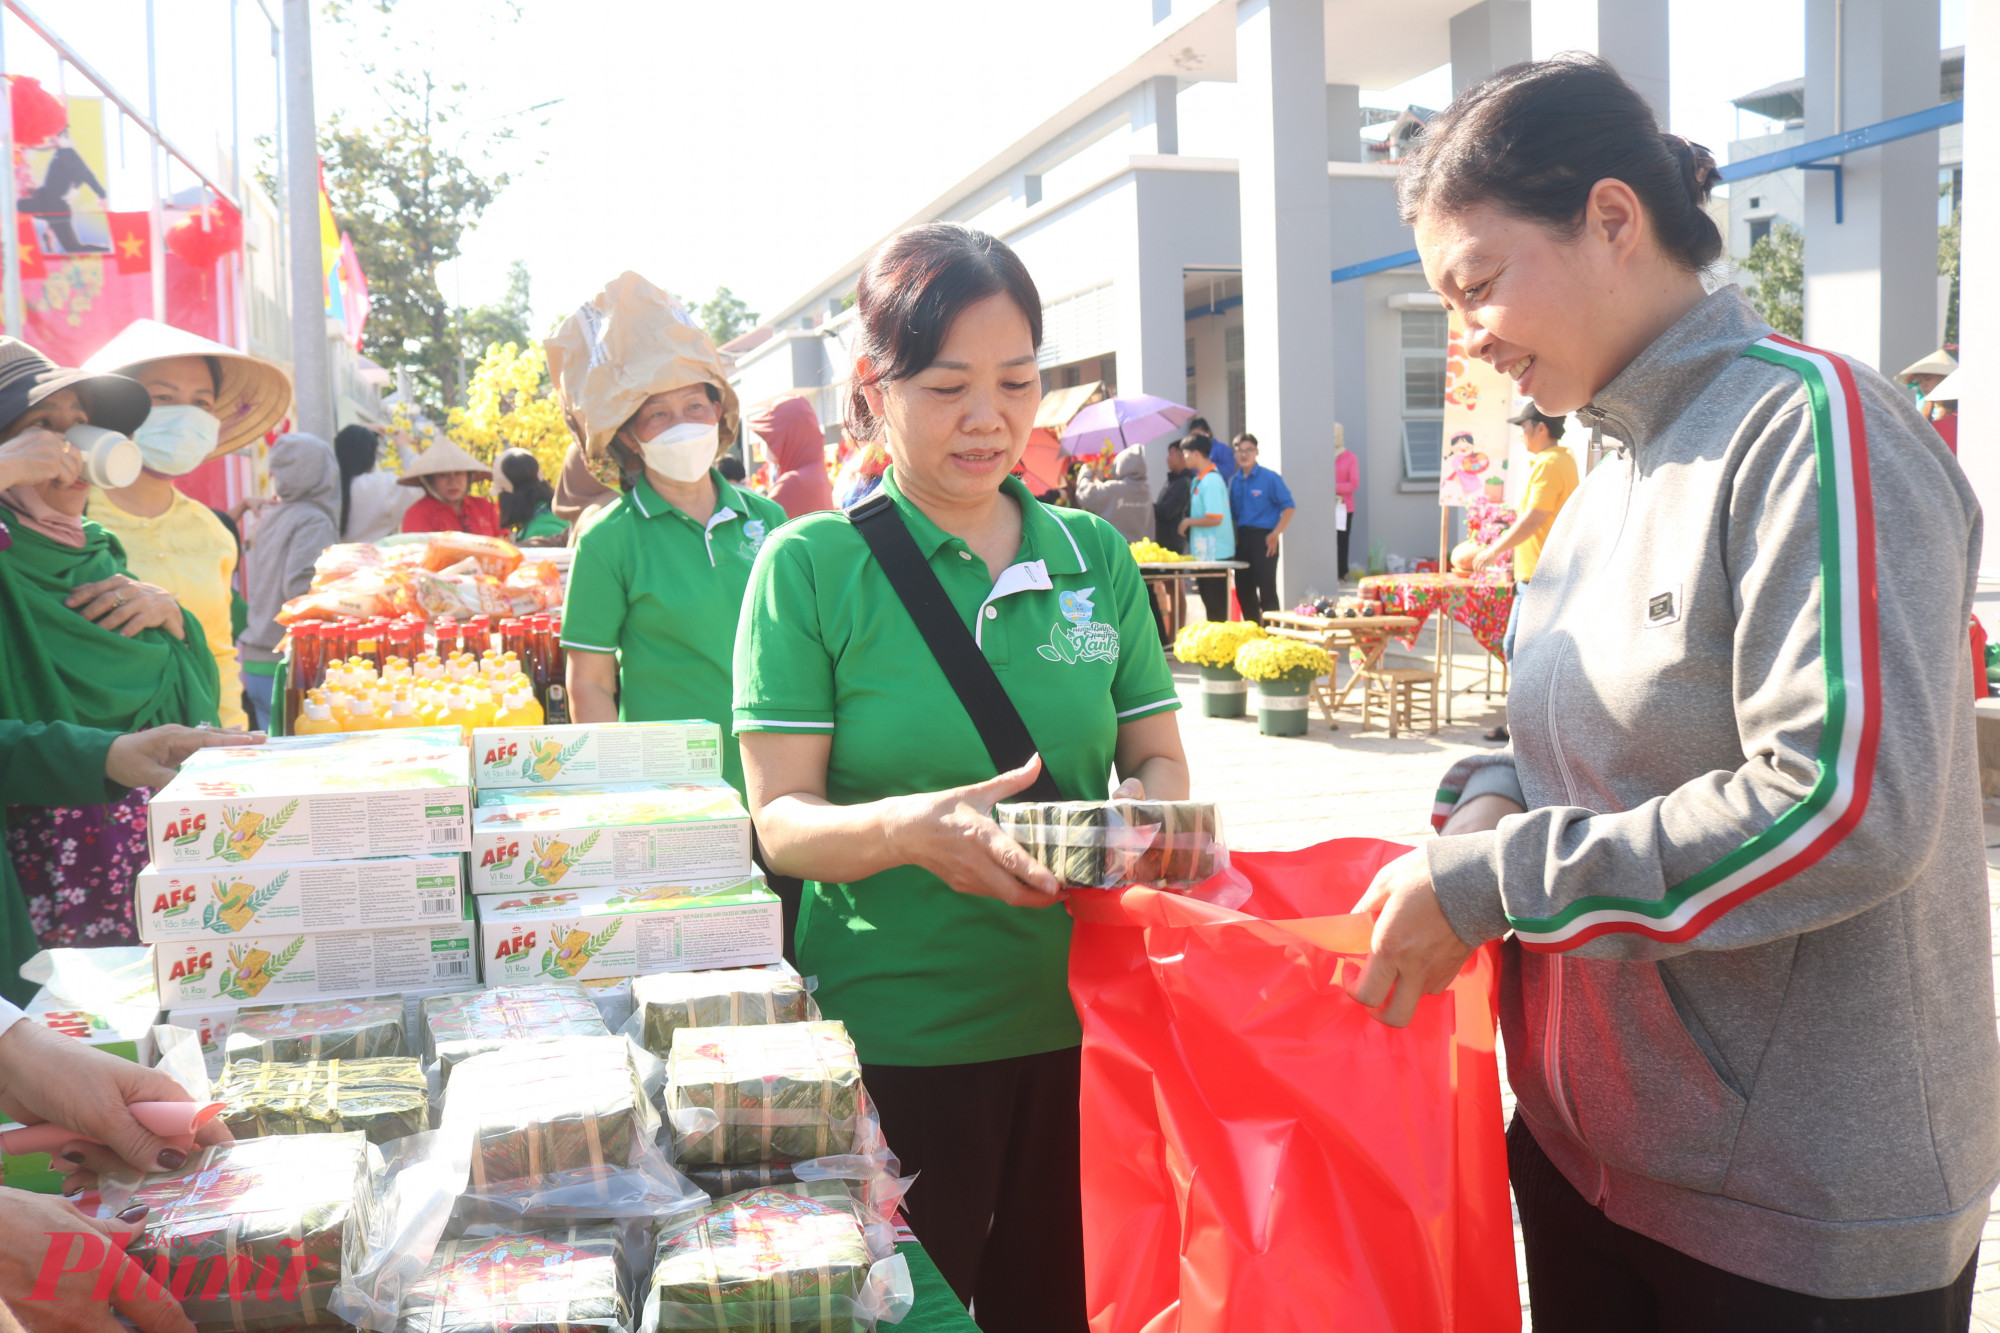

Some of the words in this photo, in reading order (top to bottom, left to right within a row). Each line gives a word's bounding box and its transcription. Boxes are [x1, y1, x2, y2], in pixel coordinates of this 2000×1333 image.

[1073, 635, 1117, 656] Xanh
[483, 742, 518, 766] AFC
[480, 807, 561, 824] AFC
[161, 812, 207, 843] AFC
[173, 847, 183, 857] Vị
[184, 847, 200, 856] Rau
[480, 841, 519, 868] AFC
[489, 873, 497, 881] Vị
[499, 872, 513, 880] Rau
[151, 884, 197, 914] AFC
[490, 892, 579, 911] AFC
[152, 919, 162, 929] Vị
[164, 918, 180, 928] Táo
[181, 917, 200, 927] Biển
[494, 931, 536, 960] AFC
[168, 951, 213, 981] AFC
[504, 965, 513, 974] Vị
[515, 964, 530, 972] Rau
[179, 986, 189, 995] Vị
[191, 985, 206, 995] Rau
